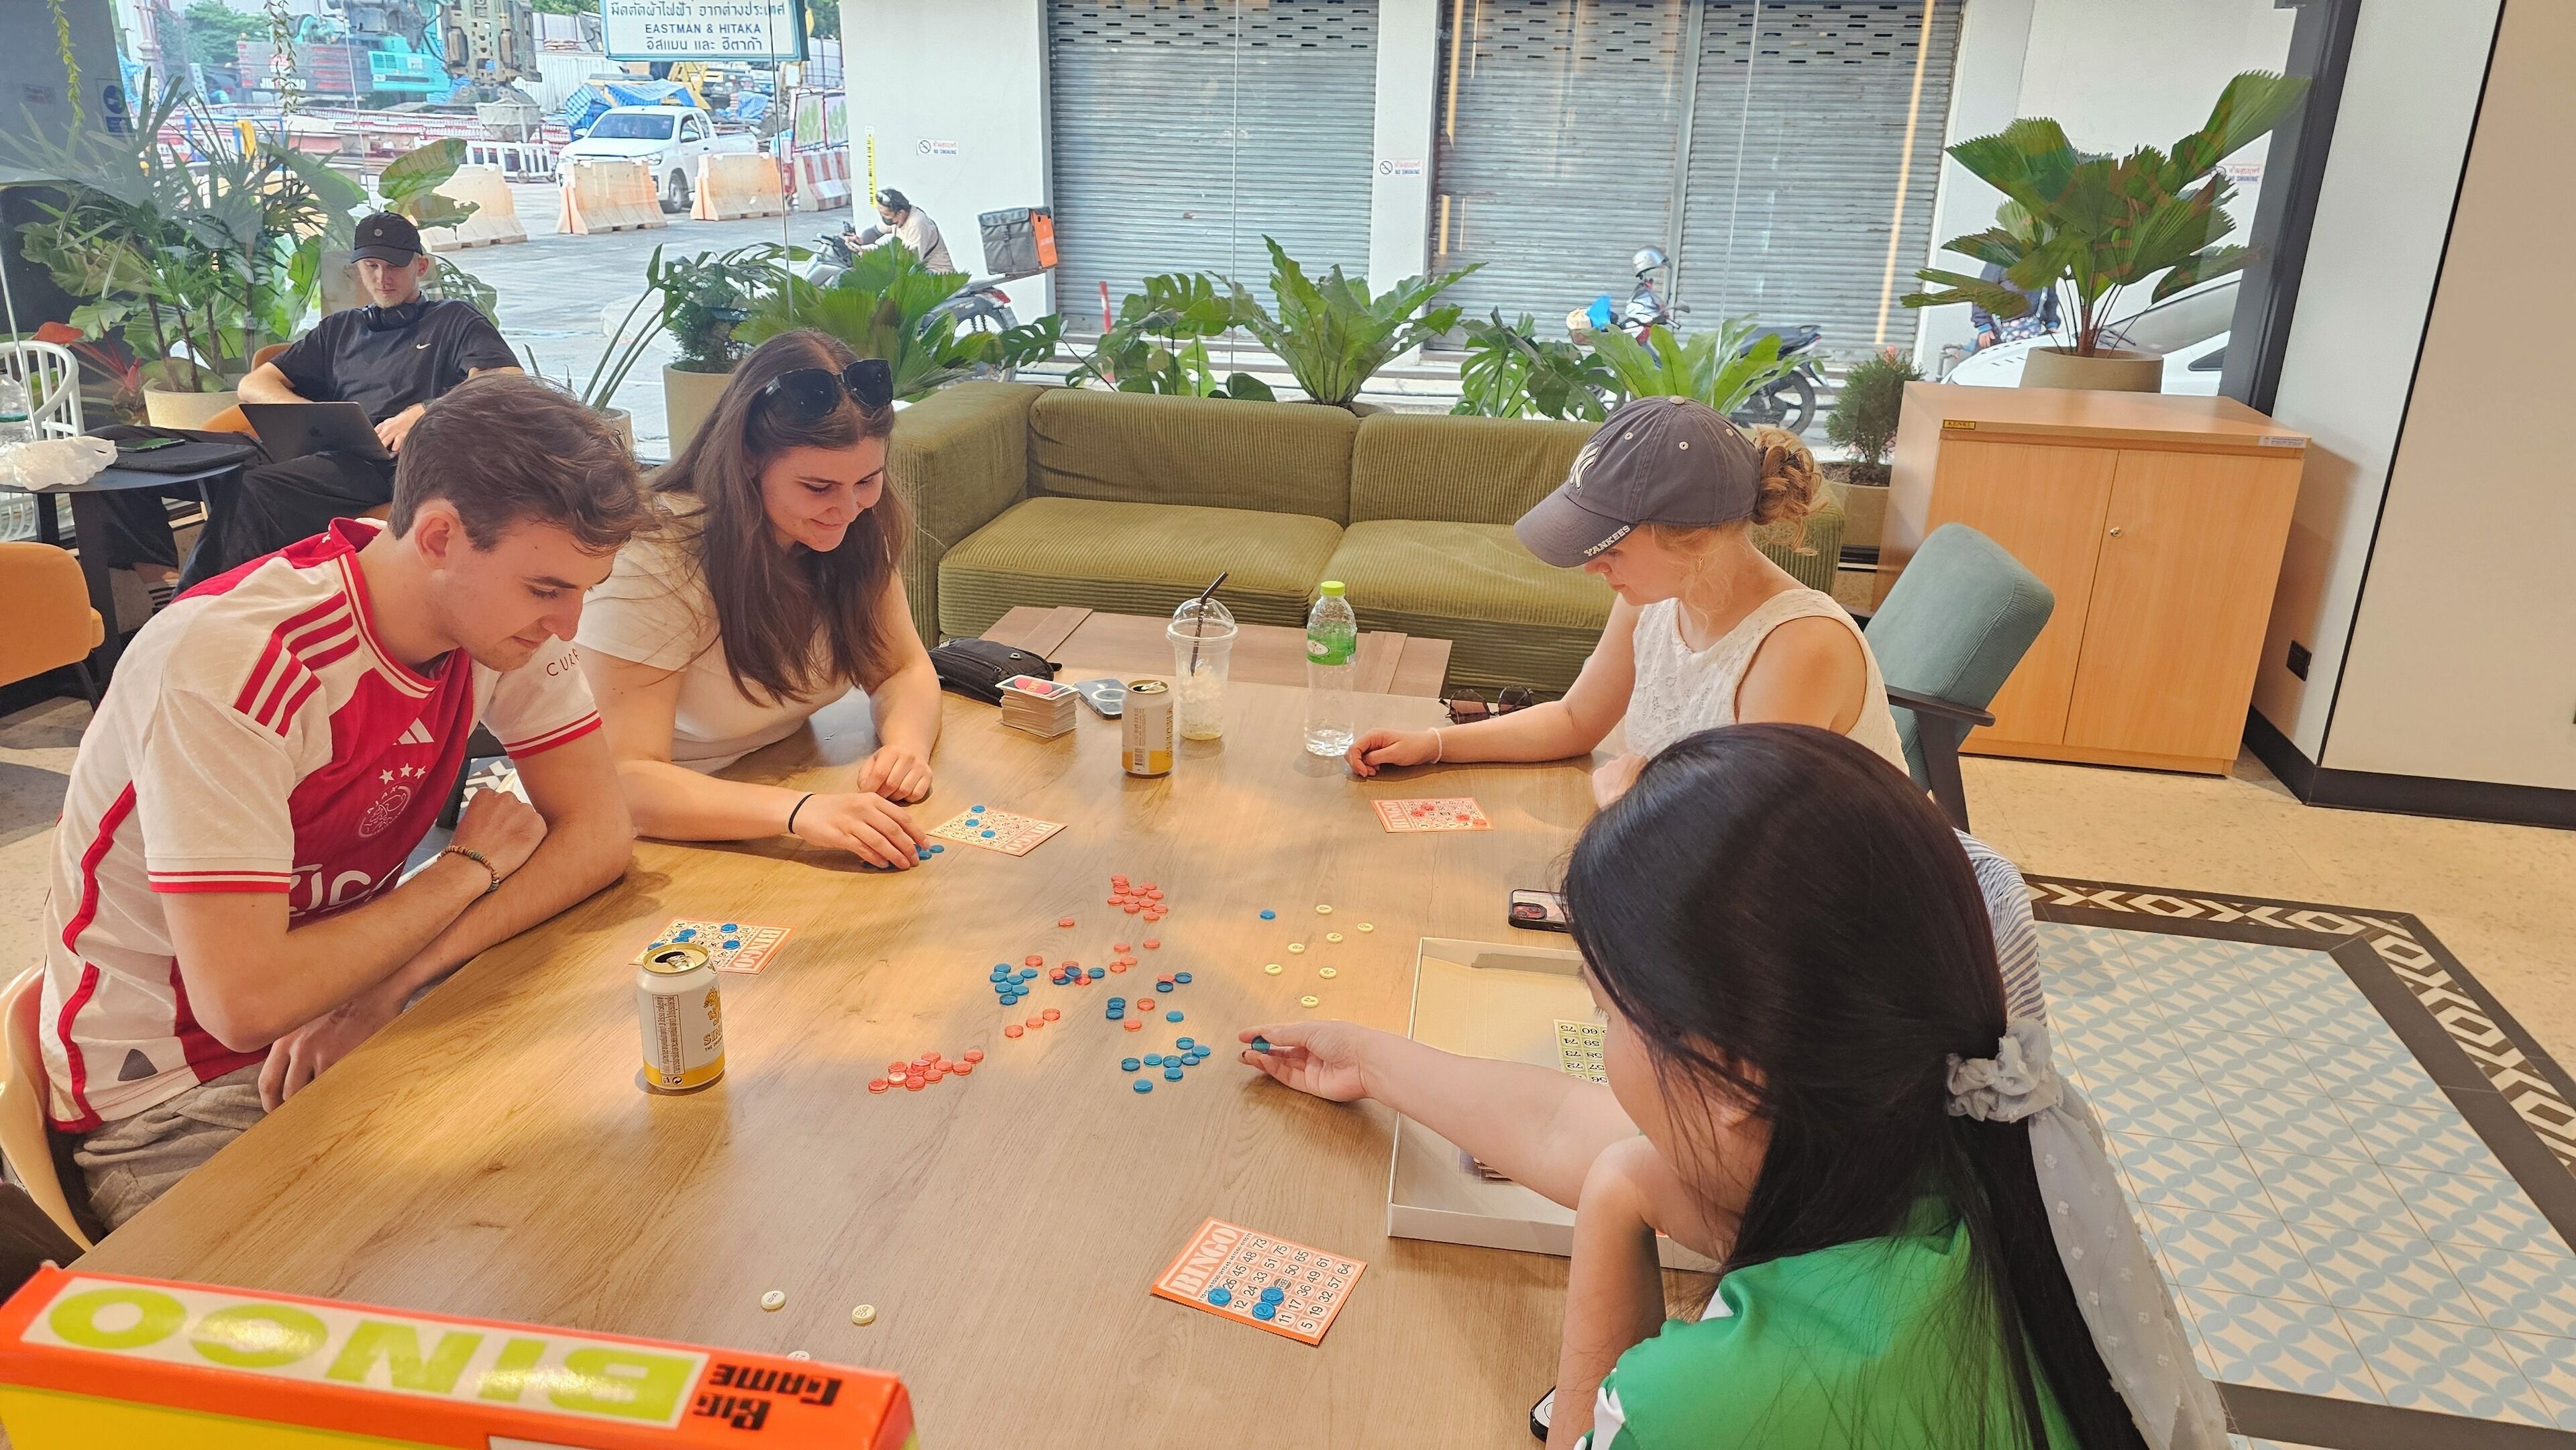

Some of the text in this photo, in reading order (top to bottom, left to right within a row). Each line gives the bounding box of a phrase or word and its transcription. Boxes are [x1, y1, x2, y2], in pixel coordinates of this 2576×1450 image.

[645, 23, 761, 34] EASTMAN & HITAKA
[1583, 525, 1631, 557] YANKEES
[733, 929, 783, 969] BINGO
[1170, 1228, 1238, 1294] BINGO
[1223, 1279, 1237, 1289] 26
[1233, 1265, 1246, 1276] 45
[1243, 1251, 1256, 1262] 48
[1252, 1239, 1267, 1248] 73
[1234, 1245, 1287, 1308] 12 24 33 51 75
[1285, 1265, 1299, 1276] 50
[1295, 1251, 1308, 1261] 65
[1289, 1299, 1301, 1308] 17
[1297, 1285, 1311, 1296] 36
[1307, 1272, 1320, 1282] 49
[1317, 1258, 1329, 1267] 61
[1309, 1306, 1323, 1315] 19
[1318, 1292, 1333, 1302] 32
[1328, 1277, 1341, 1288] 57
[1338, 1264, 1351, 1274] 64
[49, 1288, 695, 1422] BINGO
[708, 1363, 843, 1407] GAME
[693, 1392, 771, 1431] BIG
